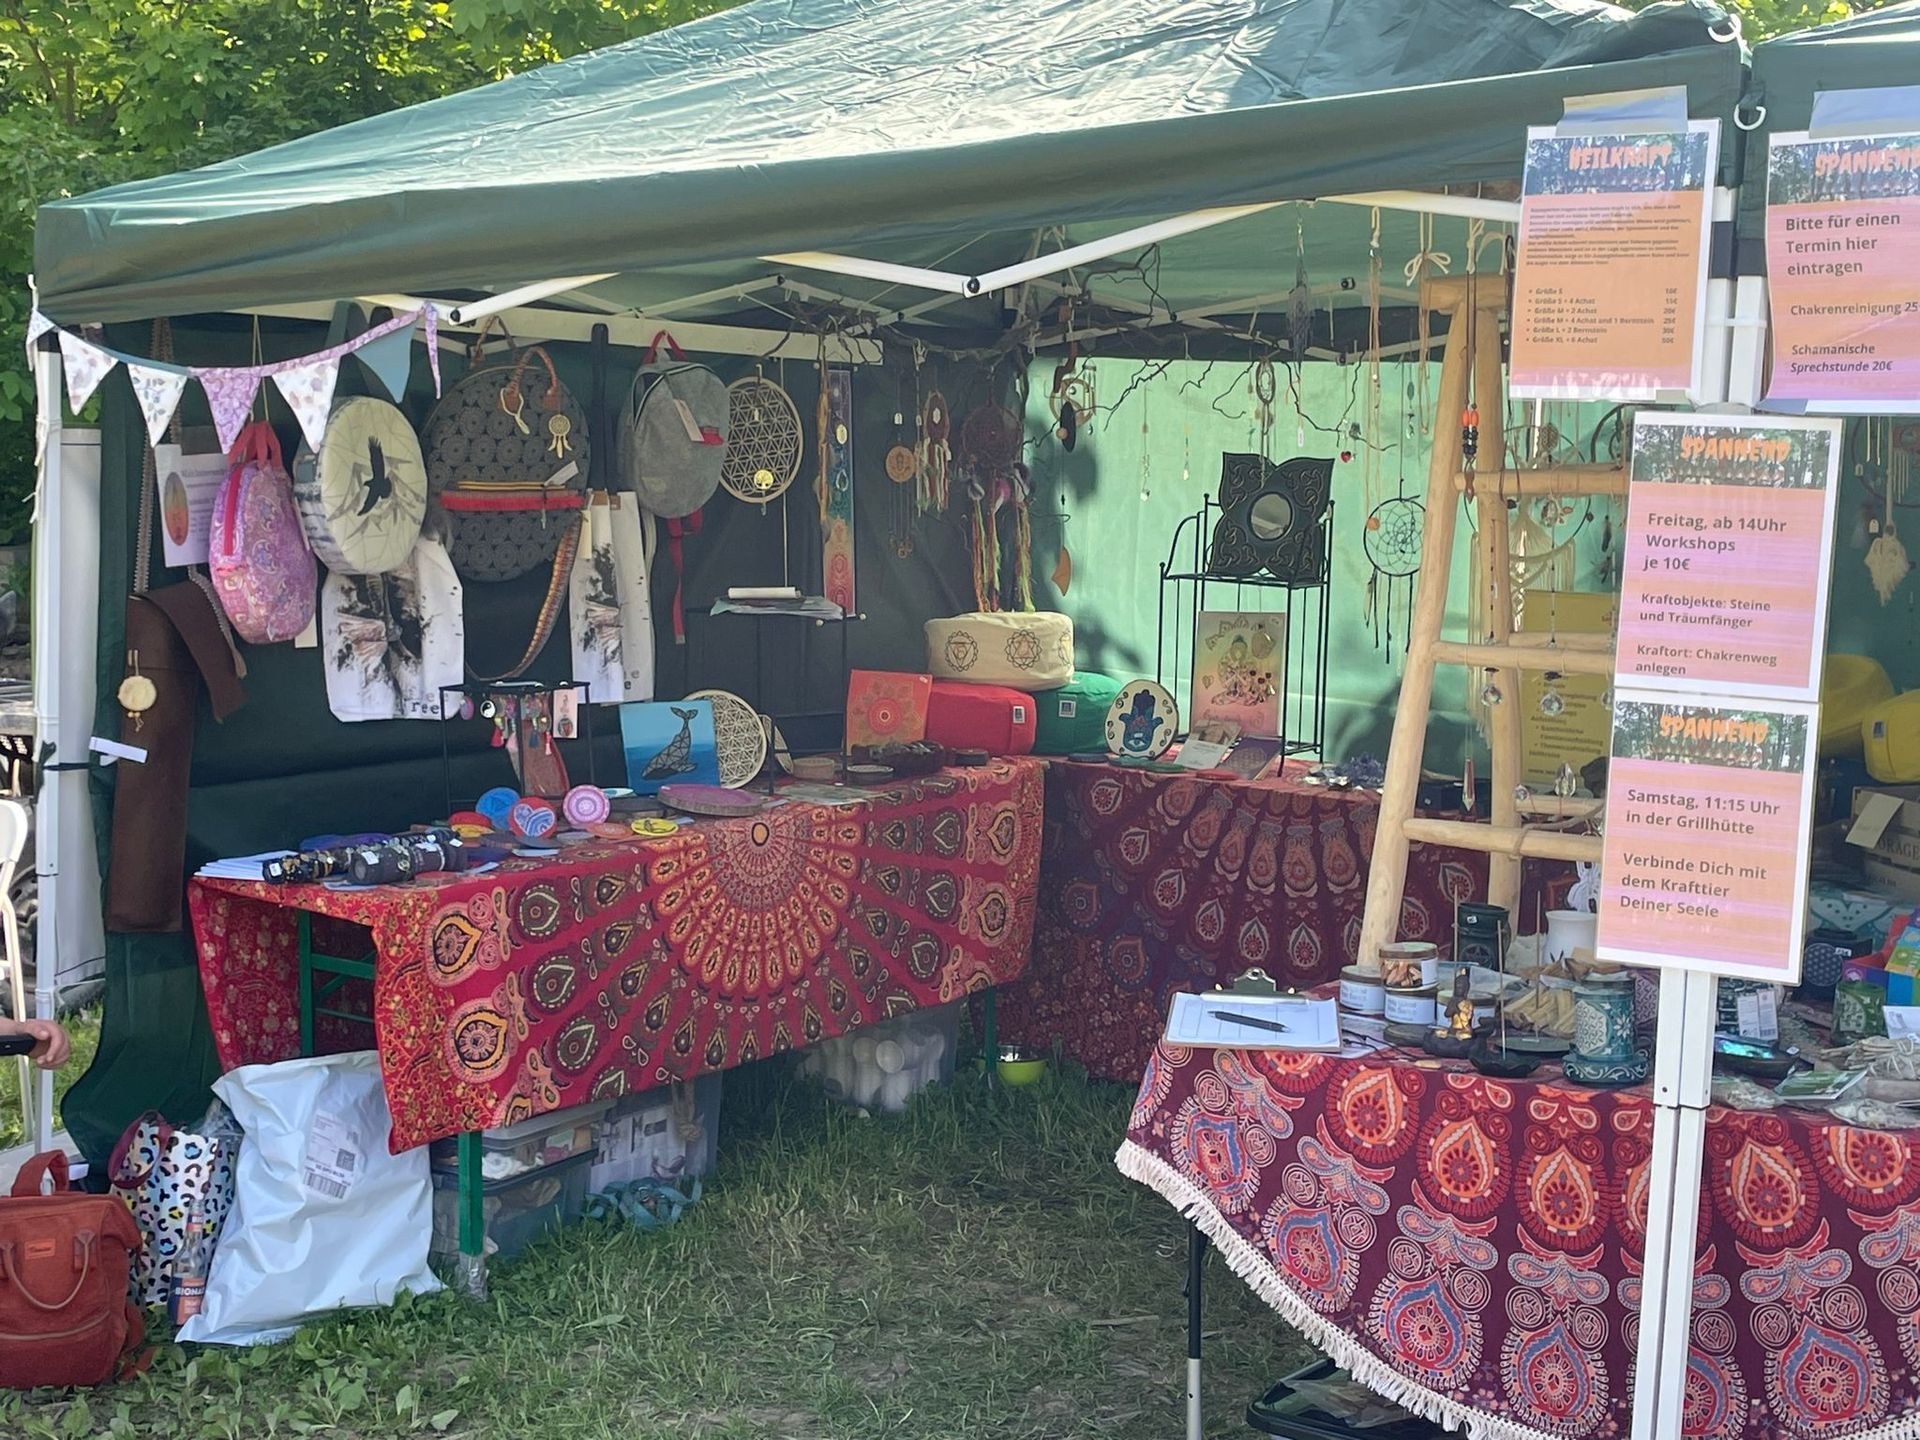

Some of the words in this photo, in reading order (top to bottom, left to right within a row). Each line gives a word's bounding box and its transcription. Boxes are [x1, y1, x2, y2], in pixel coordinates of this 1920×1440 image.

[1569, 143, 1672, 170] HEILKRAFT
[1815, 147, 1920, 176] SPANNEND
[1786, 218, 1823, 231] Bitte
[1828, 215, 1851, 229] für
[1855, 213, 1901, 227] einen
[1786, 238, 1841, 254] Termin
[1846, 237, 1878, 250] hier
[1787, 262, 1863, 277] eintragen
[1790, 302, 1901, 316] Chakrenreinigung
[1904, 301, 1920, 313] 25
[1791, 343, 1876, 356] Schamanische
[1790, 361, 1870, 375] Sprechstunde
[1872, 360, 1893, 372] 20€
[1681, 434, 1792, 464] SPANNEND
[1648, 513, 1708, 531] Freitag,
[1712, 516, 1733, 530] ab
[1738, 517, 1787, 532] 14Uhr
[1646, 534, 1736, 554] Workshops
[1642, 555, 1659, 572] je
[1663, 556, 1691, 571] 10€
[1641, 592, 1727, 609] Kraftobjekte:
[1730, 599, 1772, 612] Steine
[1640, 611, 1665, 622] und
[1668, 611, 1753, 630] Träumfänger
[1637, 644, 1693, 658] Kraftort:
[1696, 648, 1777, 668] Chakrenweg
[1635, 662, 1687, 677] anlegen
[1660, 713, 1769, 745] SPANNEND
[1627, 789, 1699, 811] Samstag,
[1705, 796, 1746, 813] 11:15
[1750, 800, 1781, 816] Uhr
[1626, 810, 1641, 823] in
[1645, 812, 1672, 827] der
[1677, 815, 1755, 835] Grillhütte
[1623, 852, 1695, 872] Verbinde
[1699, 861, 1735, 876] Dich
[1739, 866, 1768, 880] mit
[1621, 874, 1656, 889] dem
[1661, 878, 1731, 897] Krafttier
[1620, 895, 1673, 913] Deiner
[1677, 902, 1720, 918] Seele
